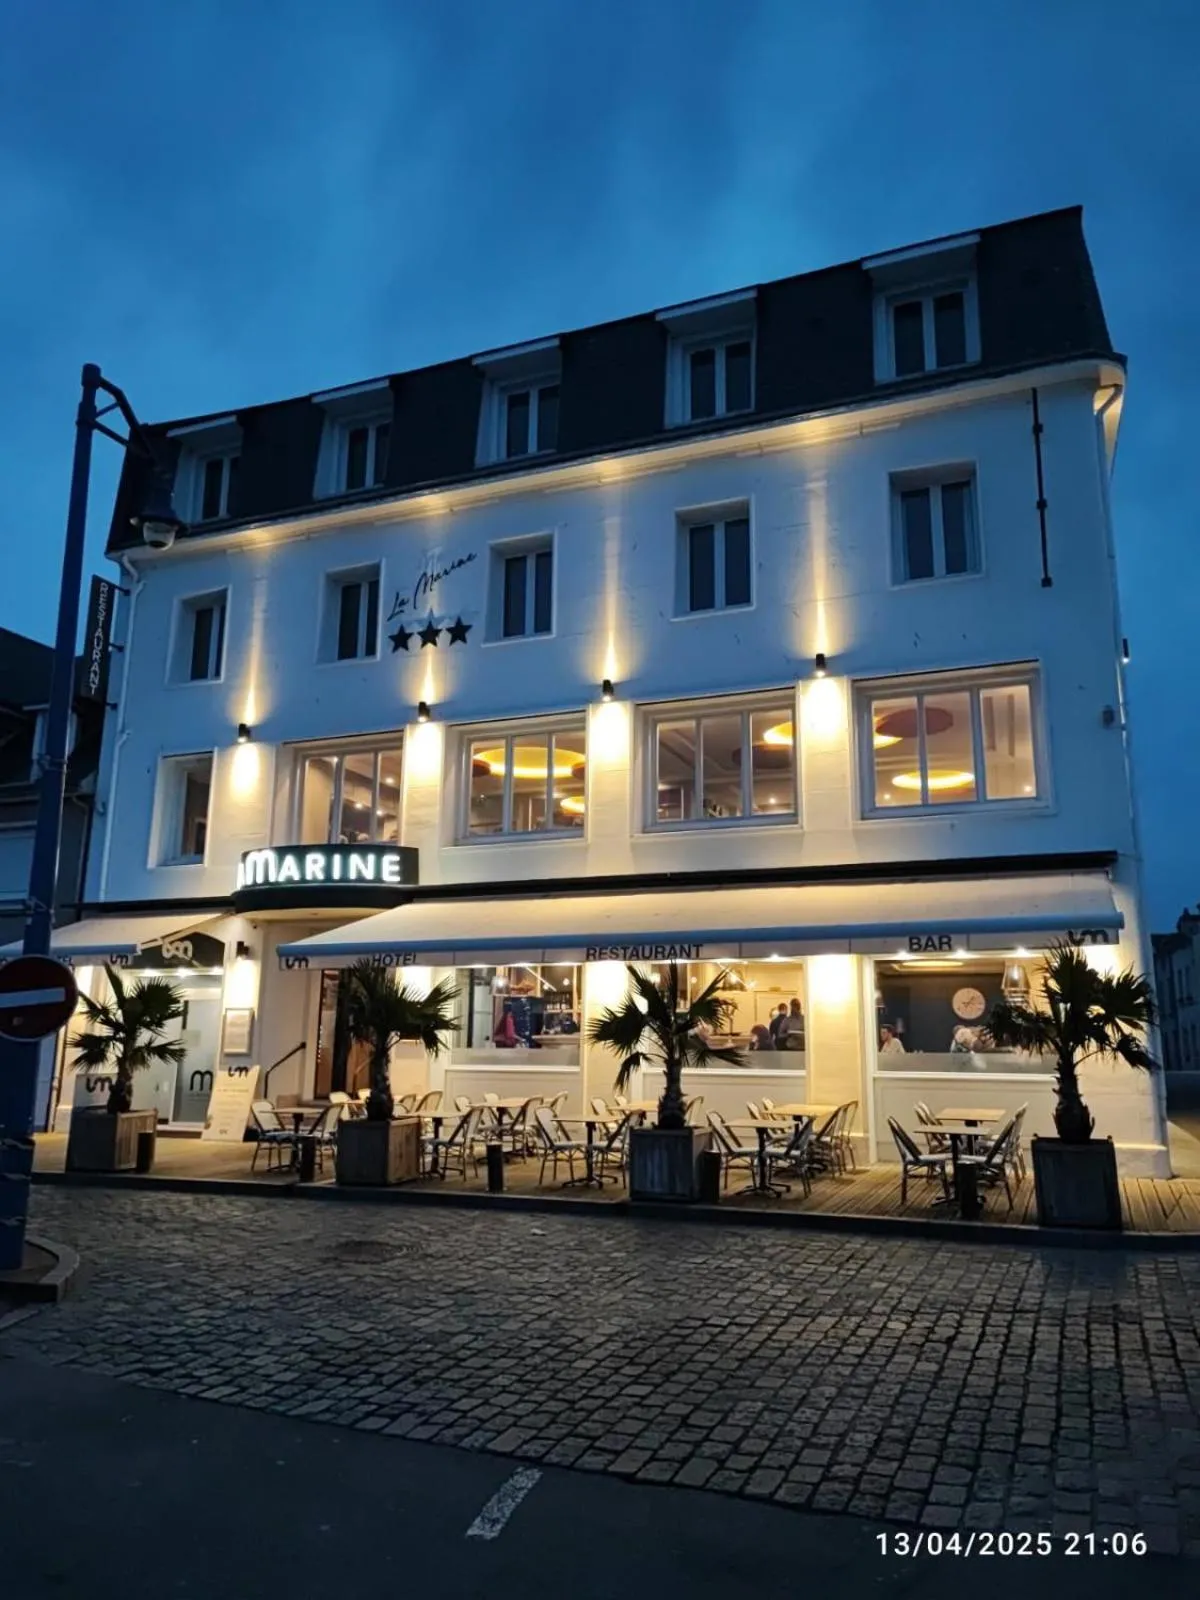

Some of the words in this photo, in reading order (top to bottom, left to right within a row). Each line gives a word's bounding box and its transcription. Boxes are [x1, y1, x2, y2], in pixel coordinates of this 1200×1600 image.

[386, 591, 410, 622] La
[413, 552, 478, 610] Marine
[89, 582, 109, 695] RESTAURANT
[245, 849, 401, 886] MARINE
[586, 943, 703, 960] RESTAURANT
[908, 935, 953, 952] BAR
[371, 952, 418, 967] HOTEL
